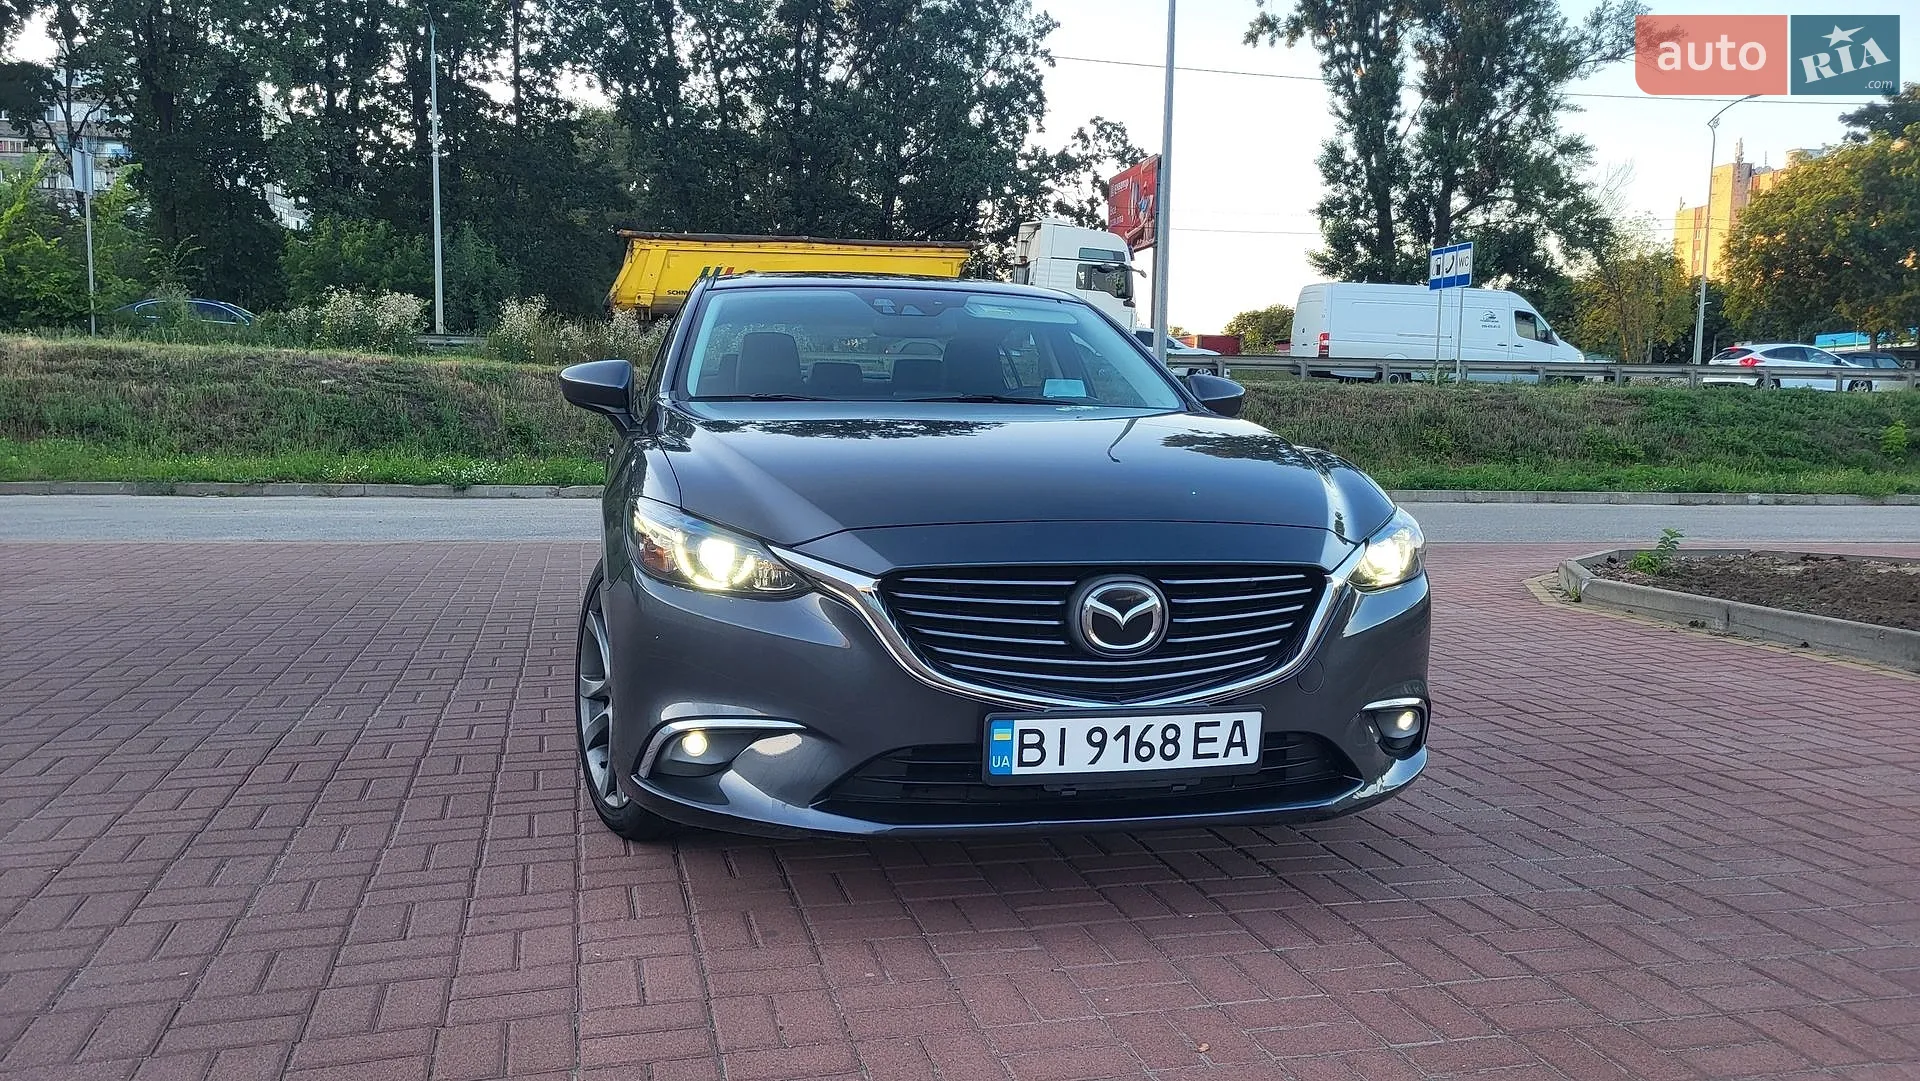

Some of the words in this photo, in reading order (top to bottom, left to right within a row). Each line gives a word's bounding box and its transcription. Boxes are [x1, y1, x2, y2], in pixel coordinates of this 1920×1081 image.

[1458, 256, 1470, 267] WC
[1017, 727, 1067, 768] BI
[1086, 723, 1181, 766] 9168
[1192, 719, 1249, 760] EA
[992, 755, 1010, 768] UA
